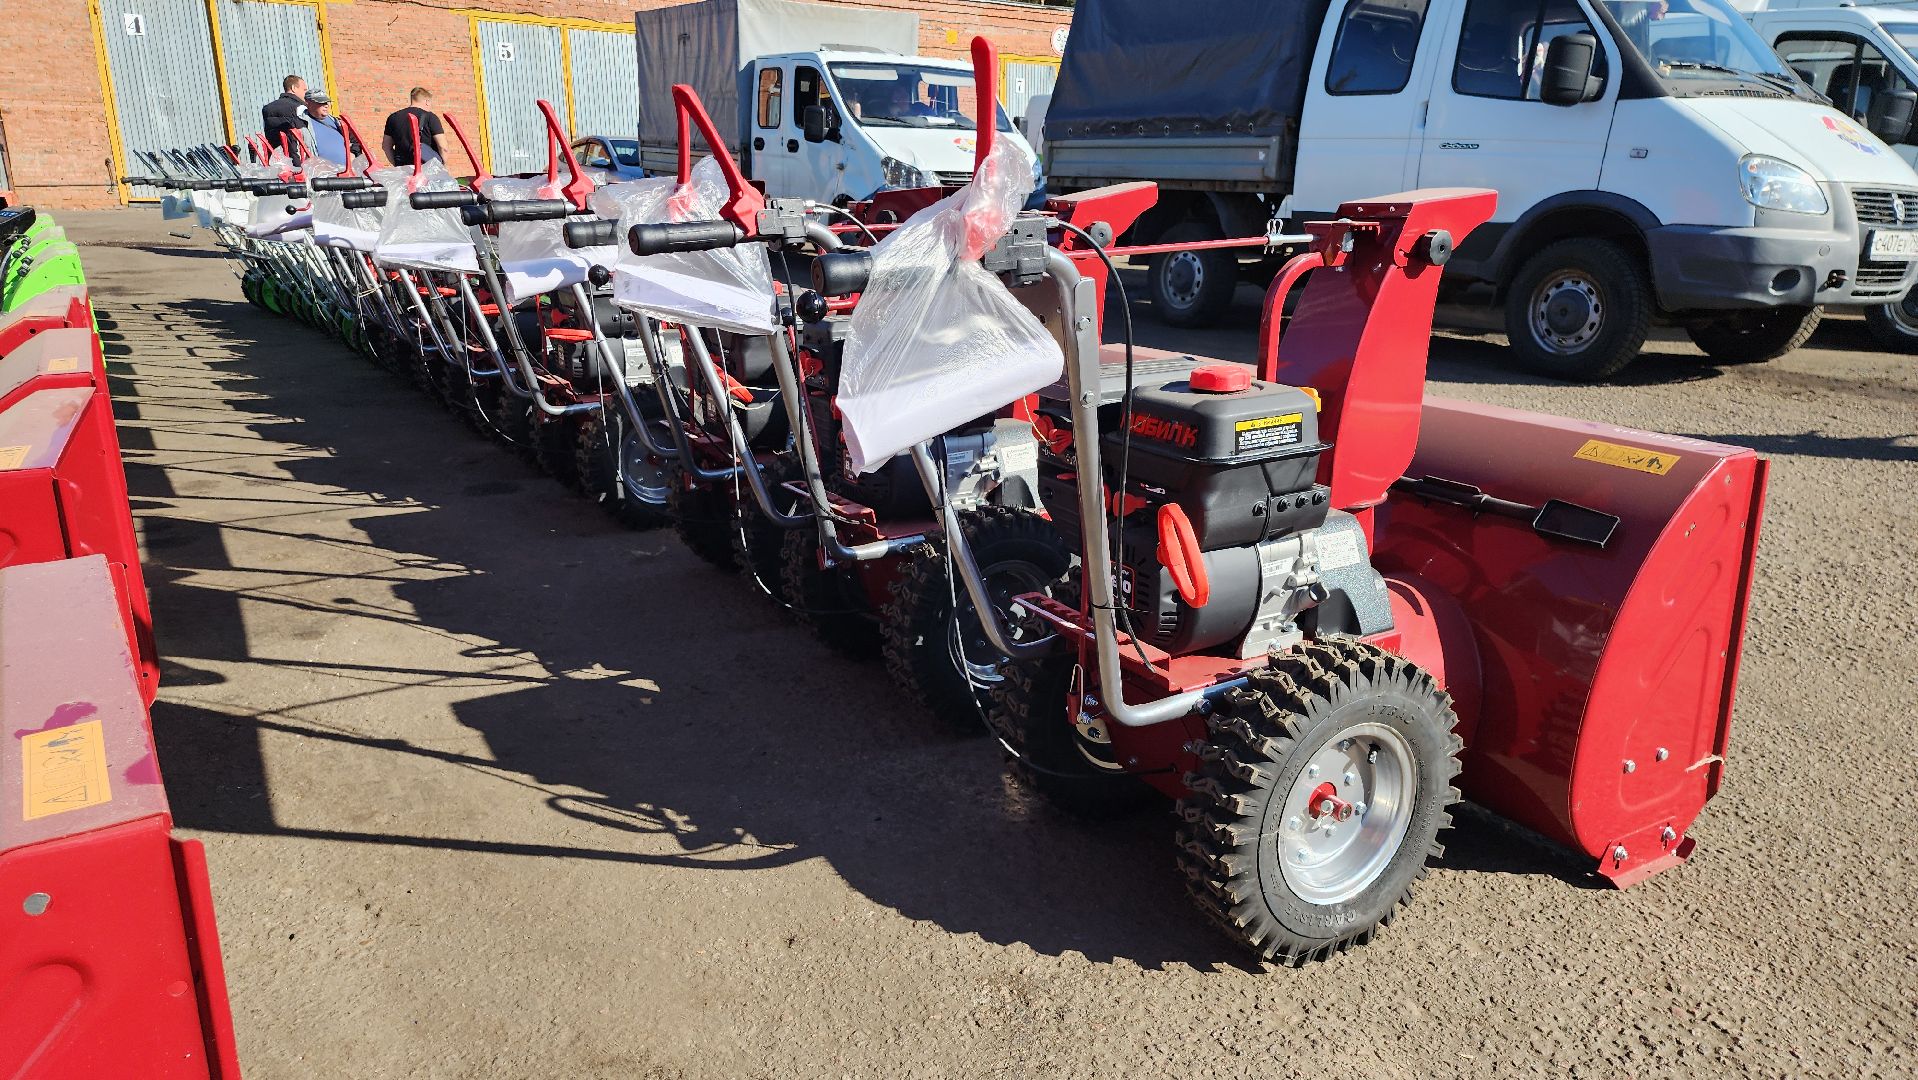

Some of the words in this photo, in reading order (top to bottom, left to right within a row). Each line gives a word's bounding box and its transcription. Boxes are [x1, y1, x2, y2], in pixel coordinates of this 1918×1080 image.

[127, 16, 142, 33] 4
[501, 44, 512, 59] 5
[1017, 80, 1023, 92] 7
[1284, 902, 1357, 928] CARLISLE
